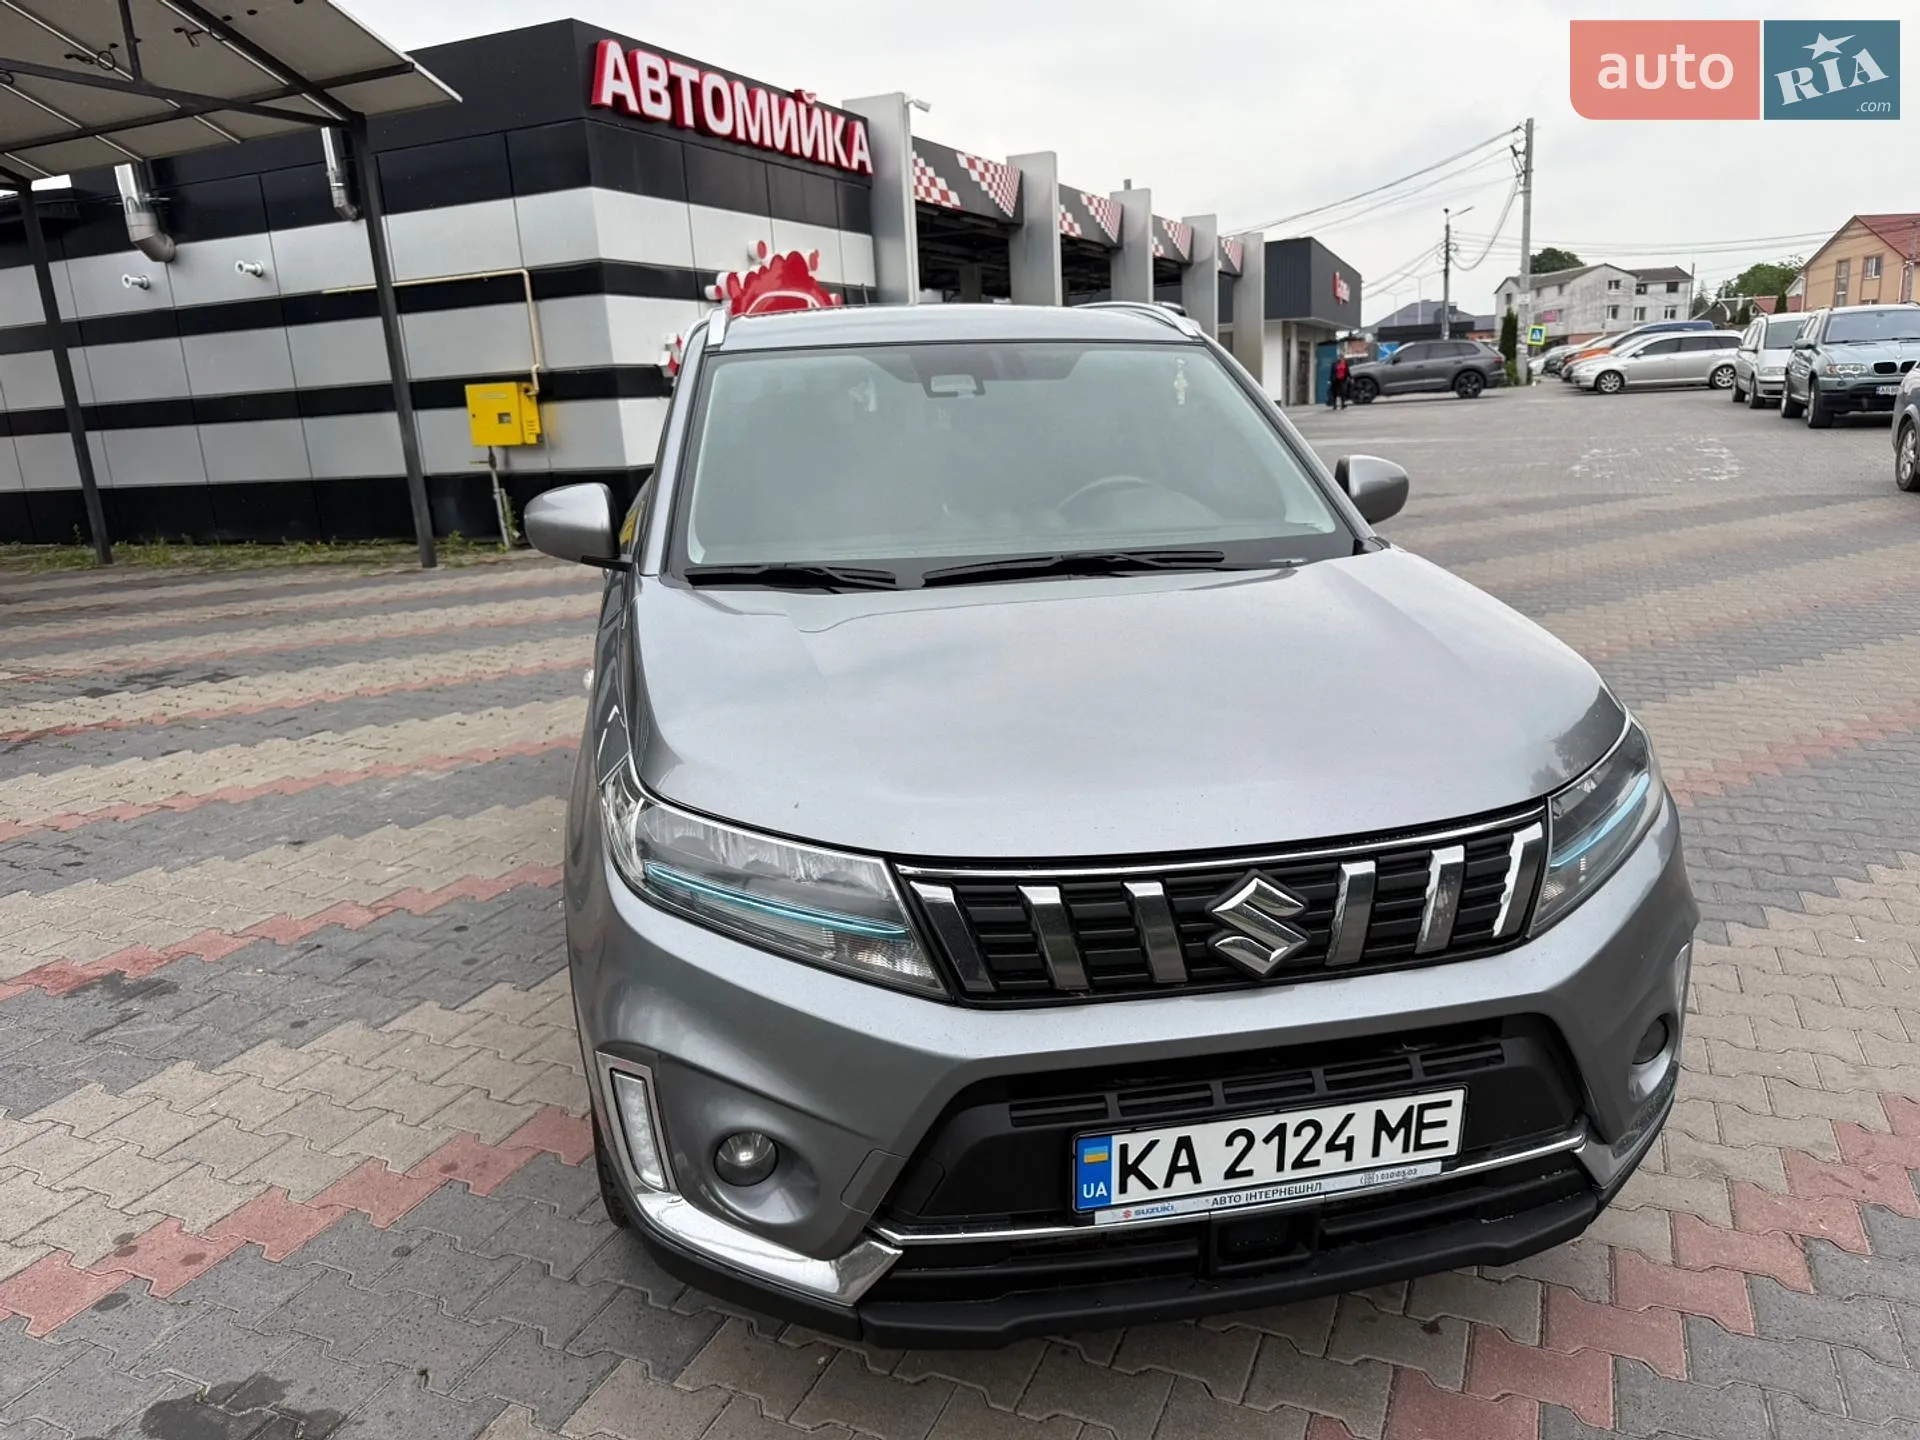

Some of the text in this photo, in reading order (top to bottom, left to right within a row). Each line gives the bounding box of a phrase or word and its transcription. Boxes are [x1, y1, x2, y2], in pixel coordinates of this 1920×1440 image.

[592, 38, 873, 176] АВТОМИЙКА
[1118, 1099, 1452, 1194] KA 2124 ME
[1083, 1182, 1108, 1199] UA
[1211, 1181, 1323, 1207] АВТО ІНТЕРНЕШНЛ
